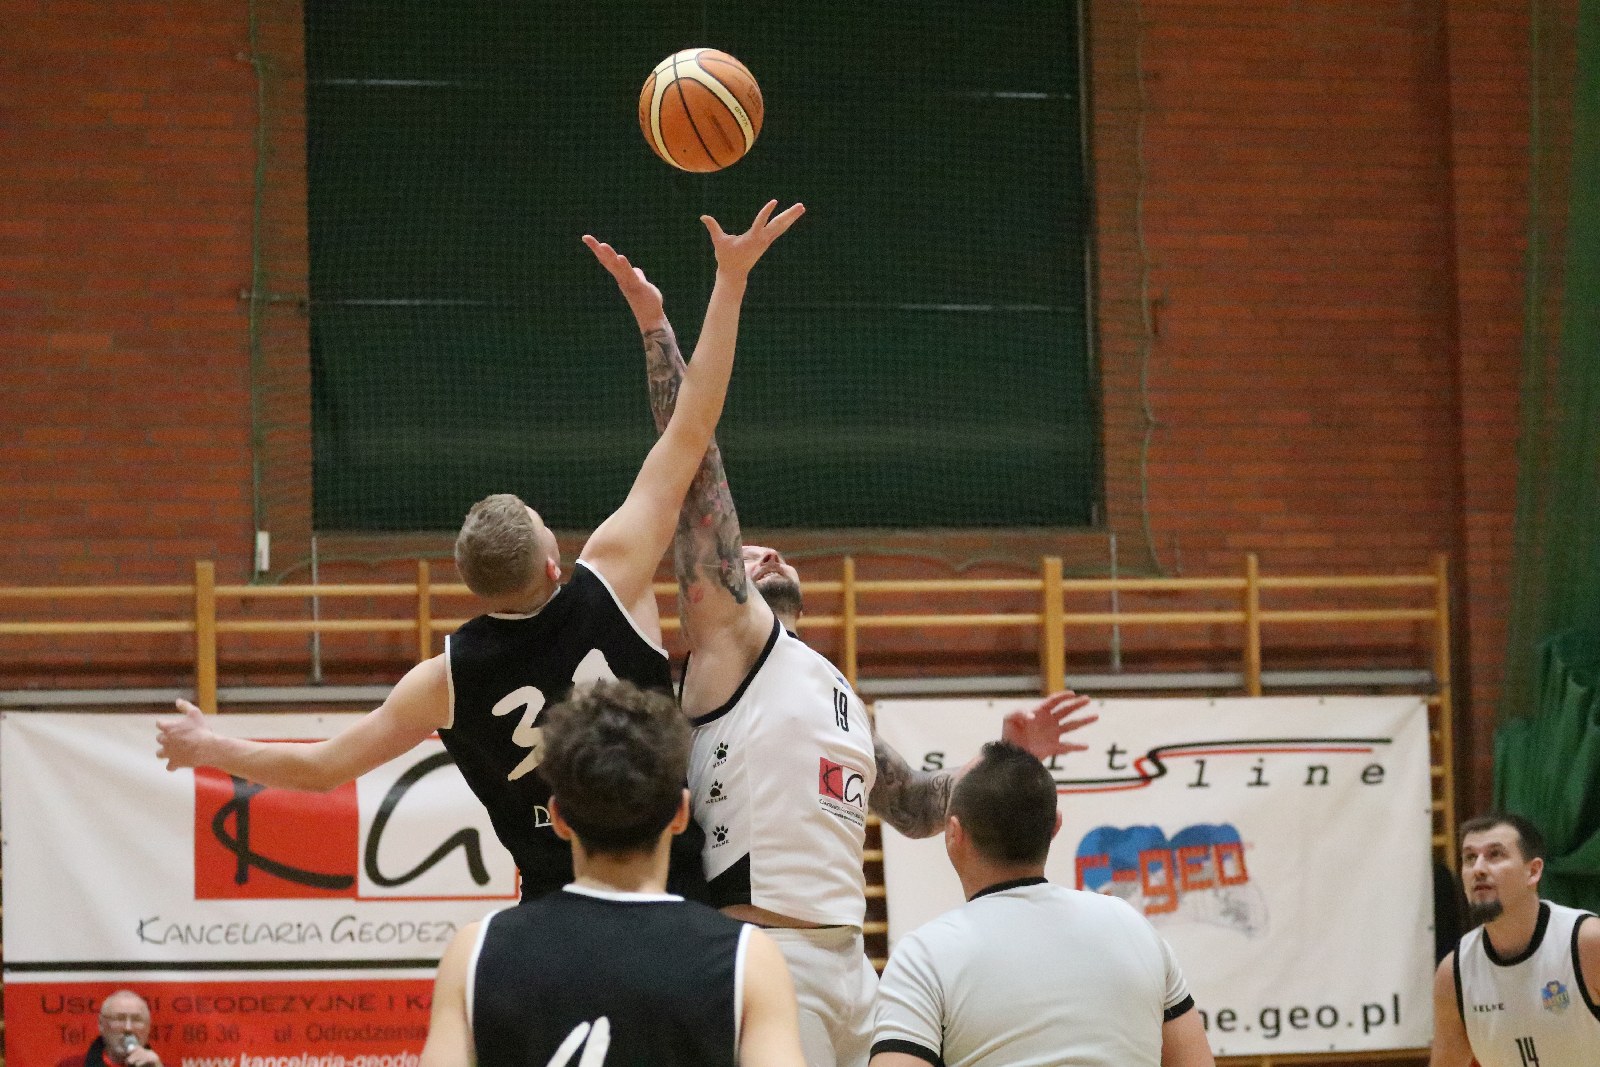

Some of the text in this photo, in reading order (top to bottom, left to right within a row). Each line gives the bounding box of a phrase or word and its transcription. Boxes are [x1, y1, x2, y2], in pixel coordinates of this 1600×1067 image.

[833, 687, 849, 732] 19
[1187, 758, 1385, 788] line
[136, 916, 322, 945] KANCELARIA
[172, 993, 375, 1013] GEODEZYJNE
